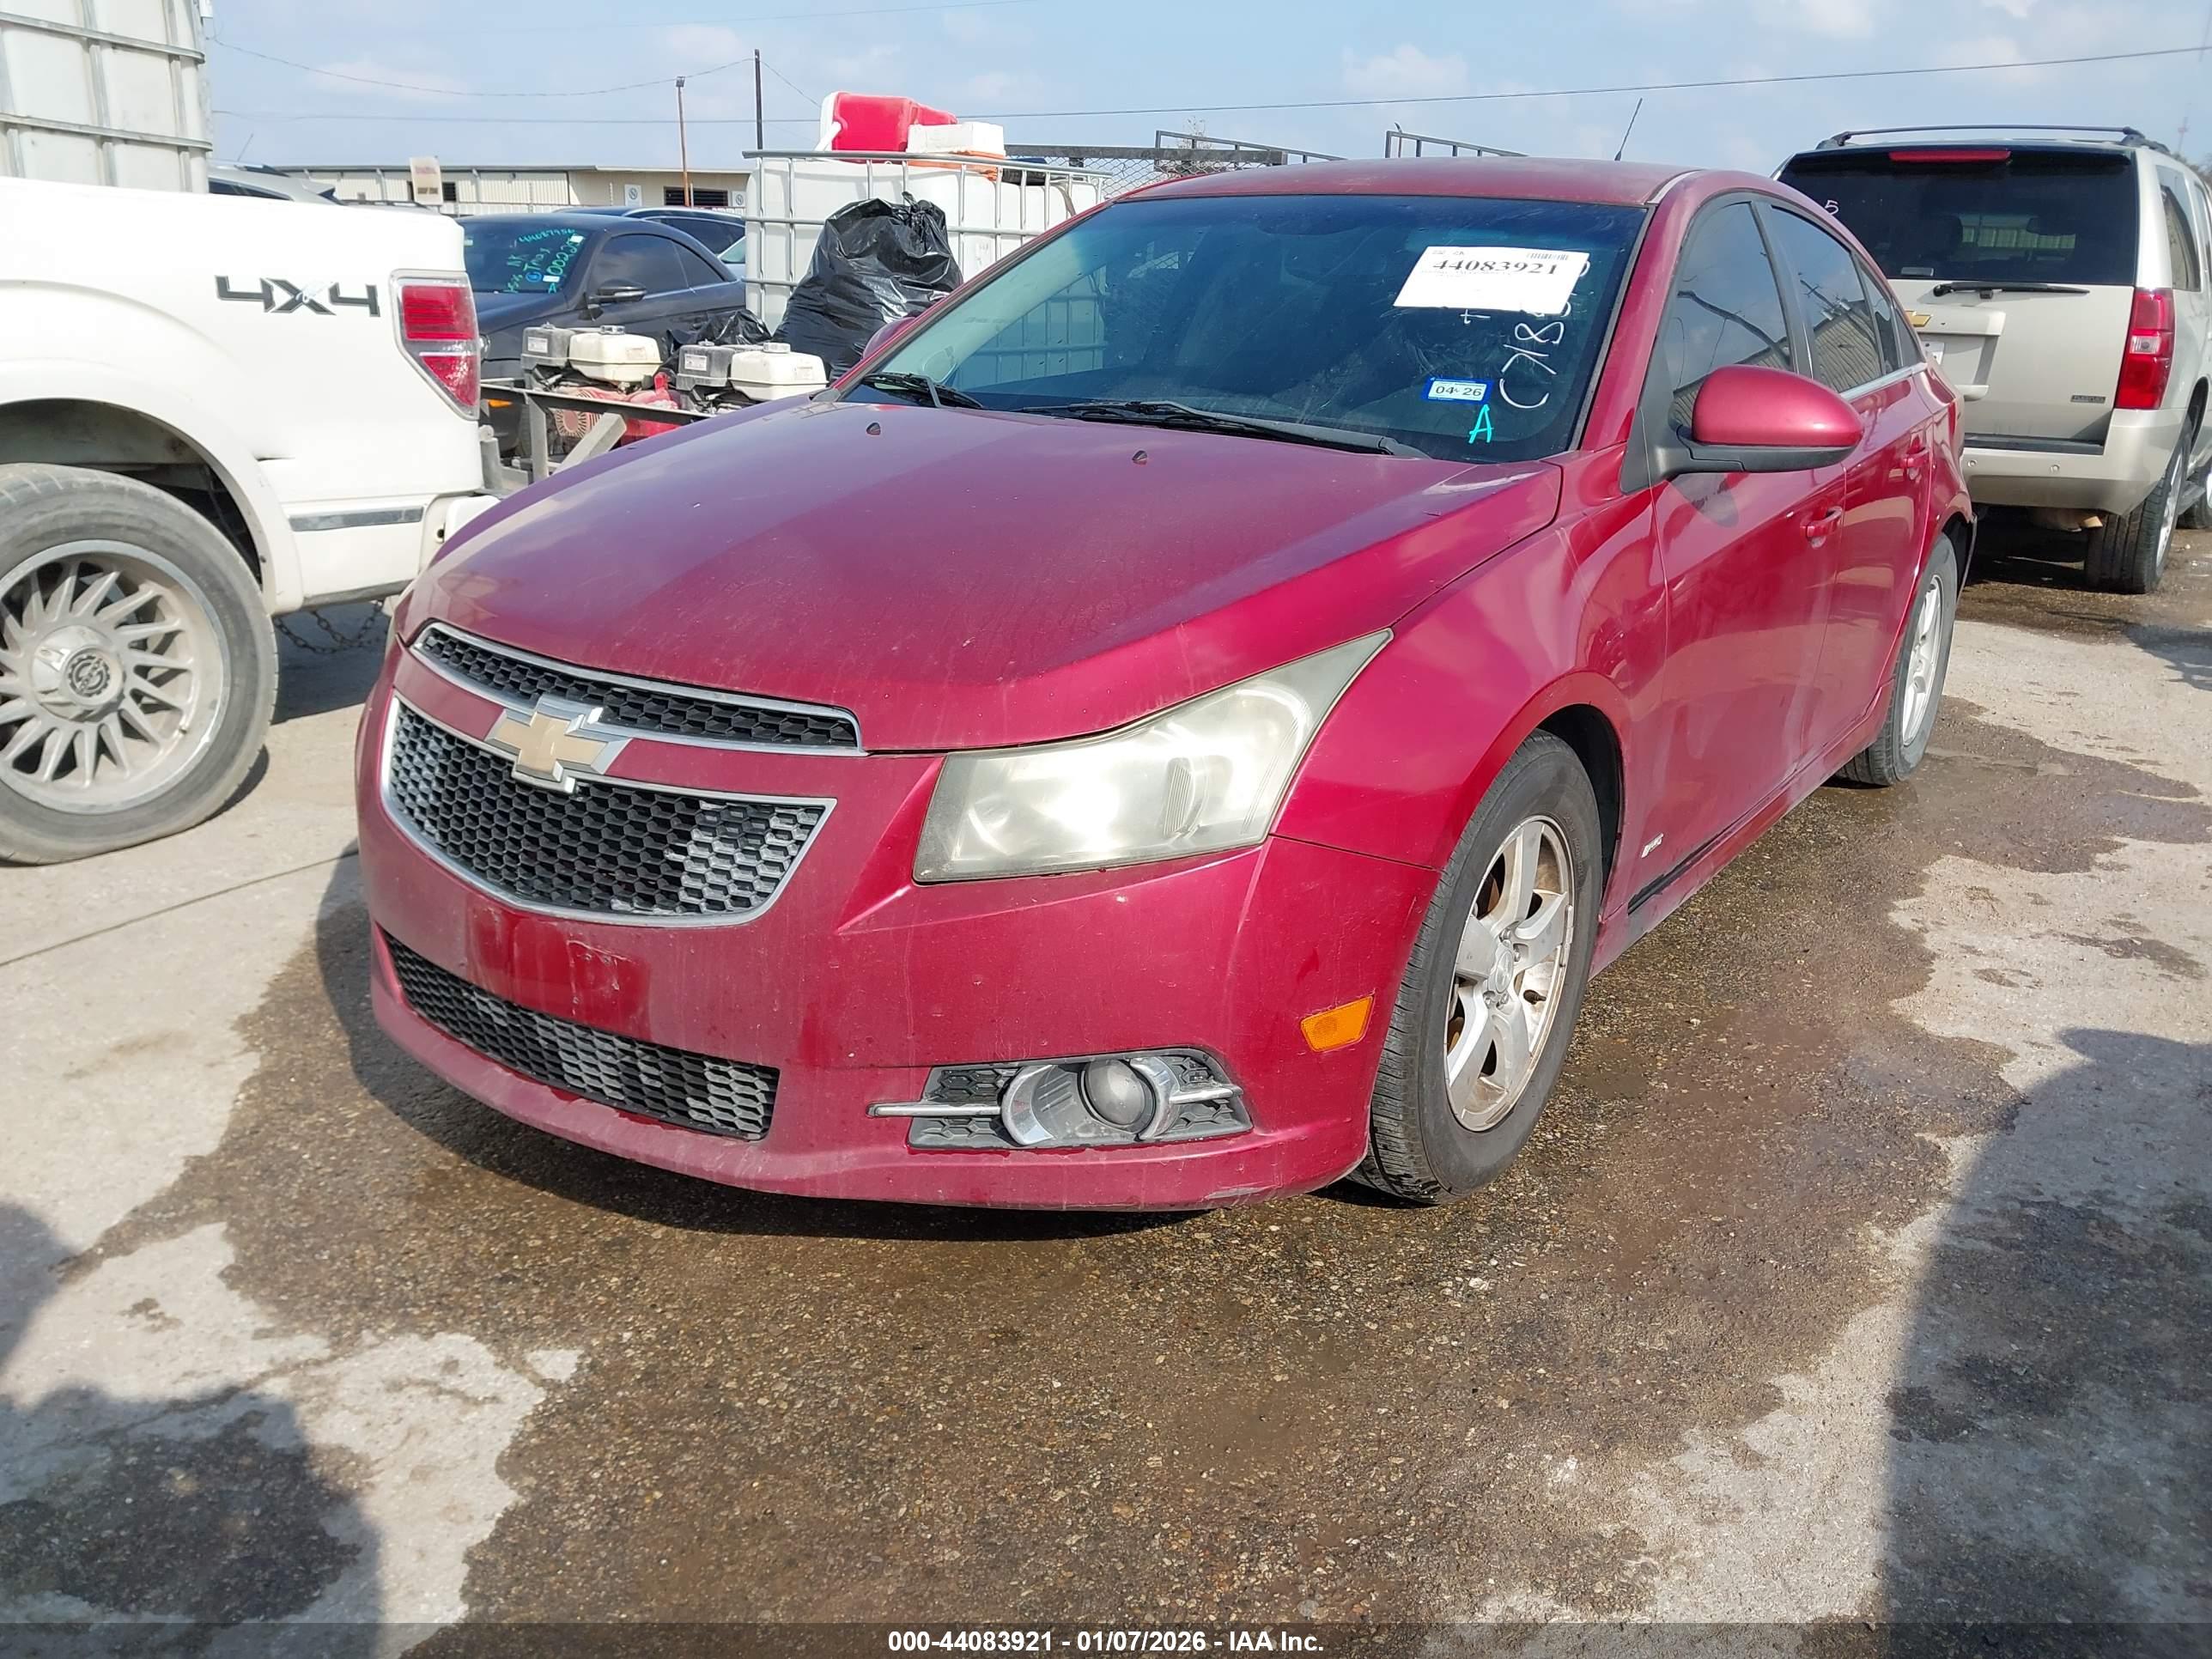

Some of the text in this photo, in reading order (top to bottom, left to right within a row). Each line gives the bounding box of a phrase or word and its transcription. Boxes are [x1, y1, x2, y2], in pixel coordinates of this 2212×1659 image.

[1824, 199, 1839, 216] 5
[1432, 259, 1559, 276] 44083921
[1435, 386, 1483, 397] 04 26
[1469, 404, 1494, 444] A
